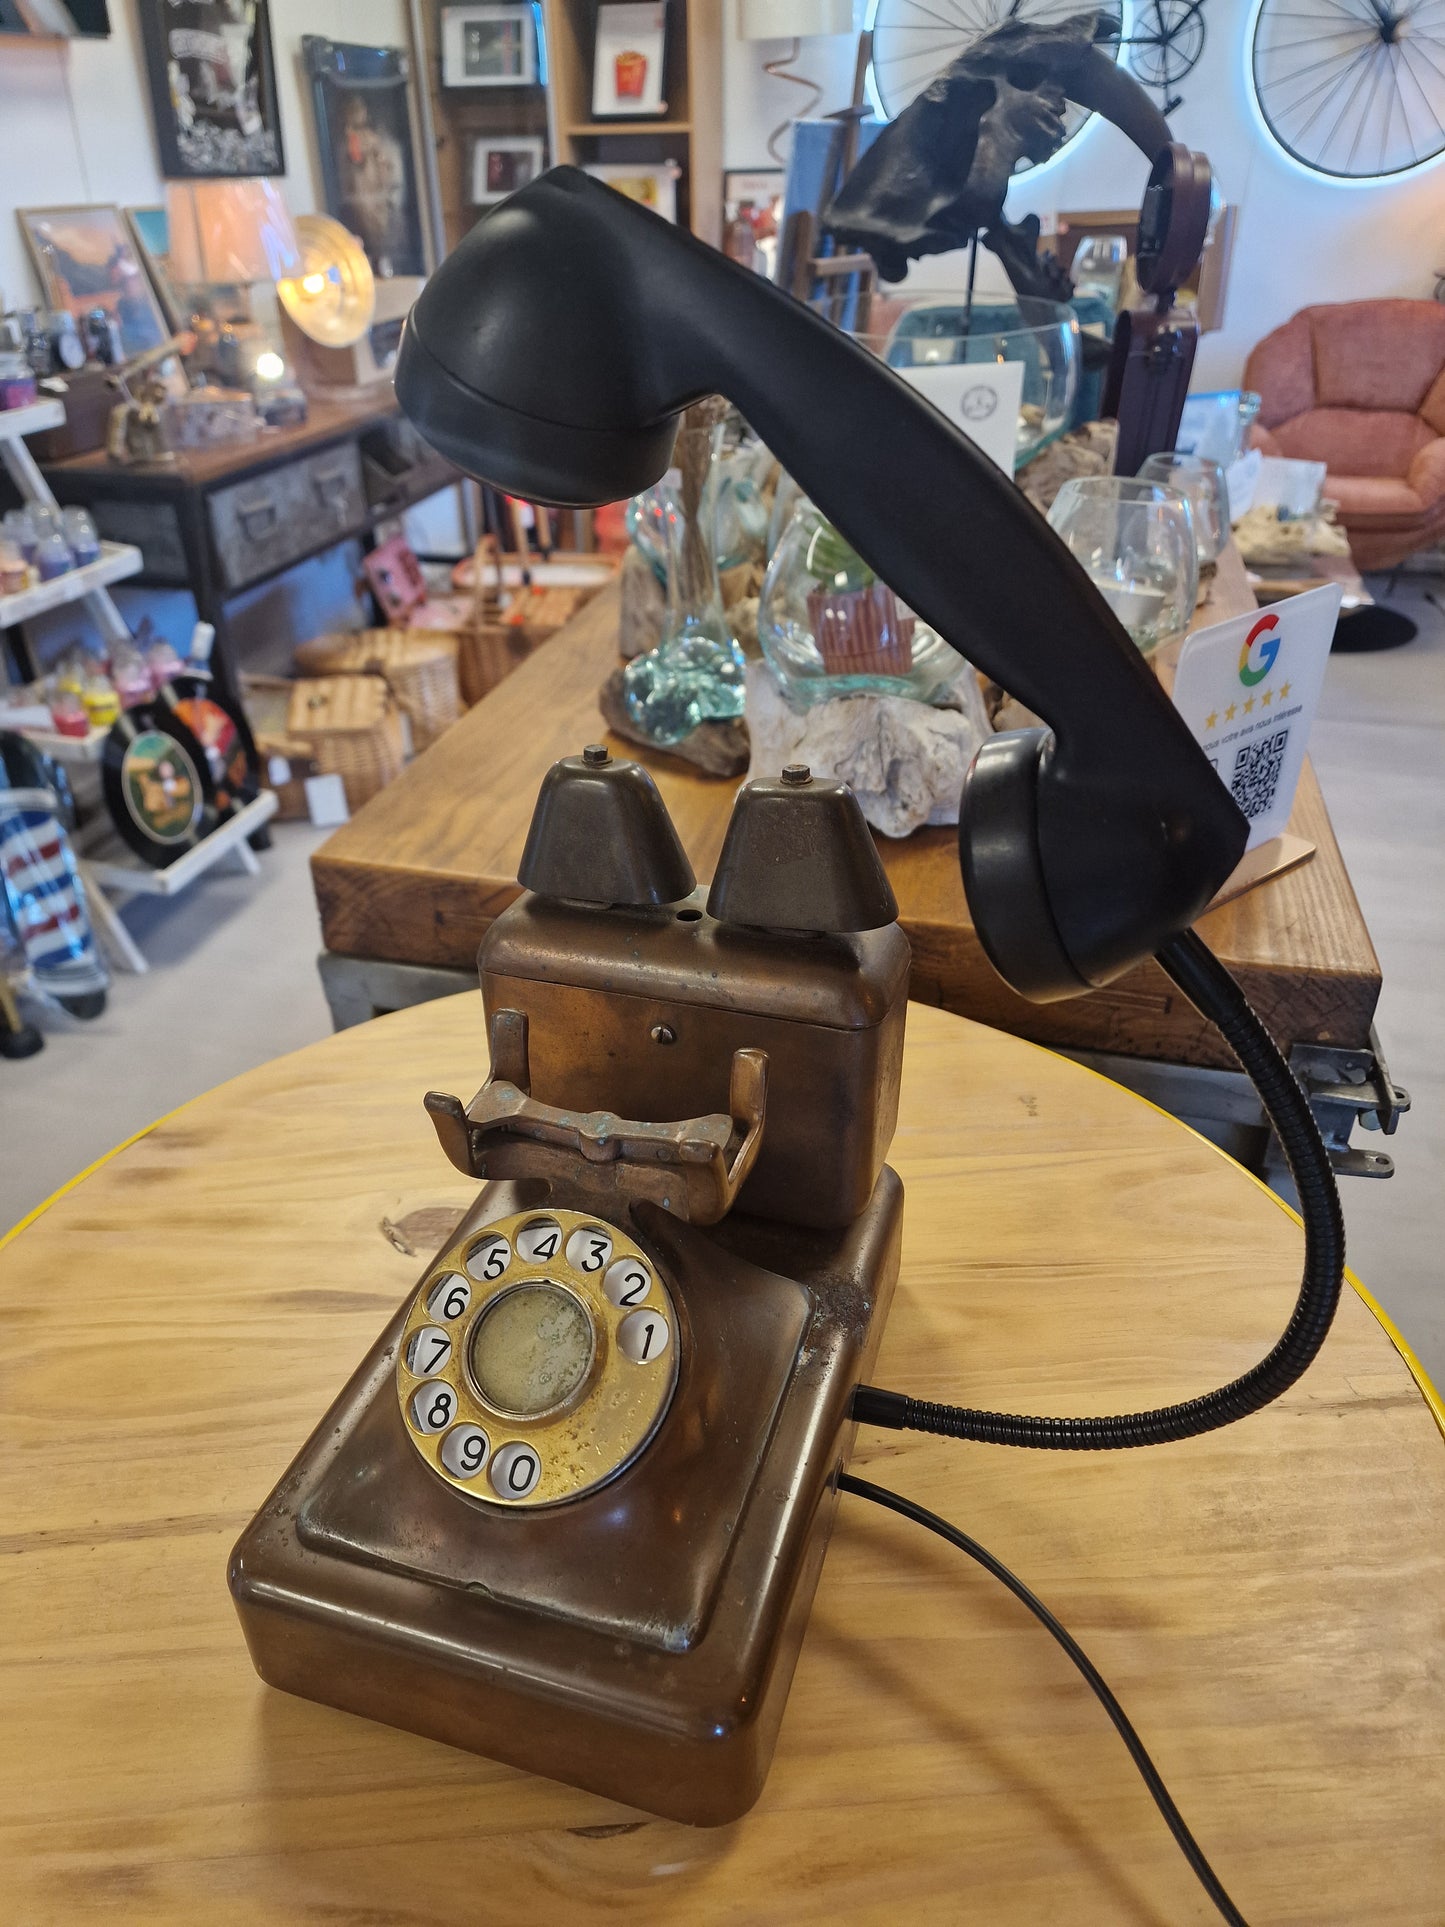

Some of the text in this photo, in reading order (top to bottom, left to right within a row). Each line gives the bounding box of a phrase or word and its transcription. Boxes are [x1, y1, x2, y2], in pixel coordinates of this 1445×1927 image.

[1238, 613, 1282, 687] G
[483, 1248, 508, 1281] 5
[533, 1233, 559, 1261] 4
[581, 1240, 608, 1273] 3
[443, 1287, 469, 1320] 6
[619, 1273, 646, 1307] 2
[423, 1338, 451, 1374] 7
[641, 1323, 655, 1360] 1
[427, 1393, 452, 1429] 8
[460, 1435, 486, 1472] 9
[508, 1454, 535, 1492] 0
